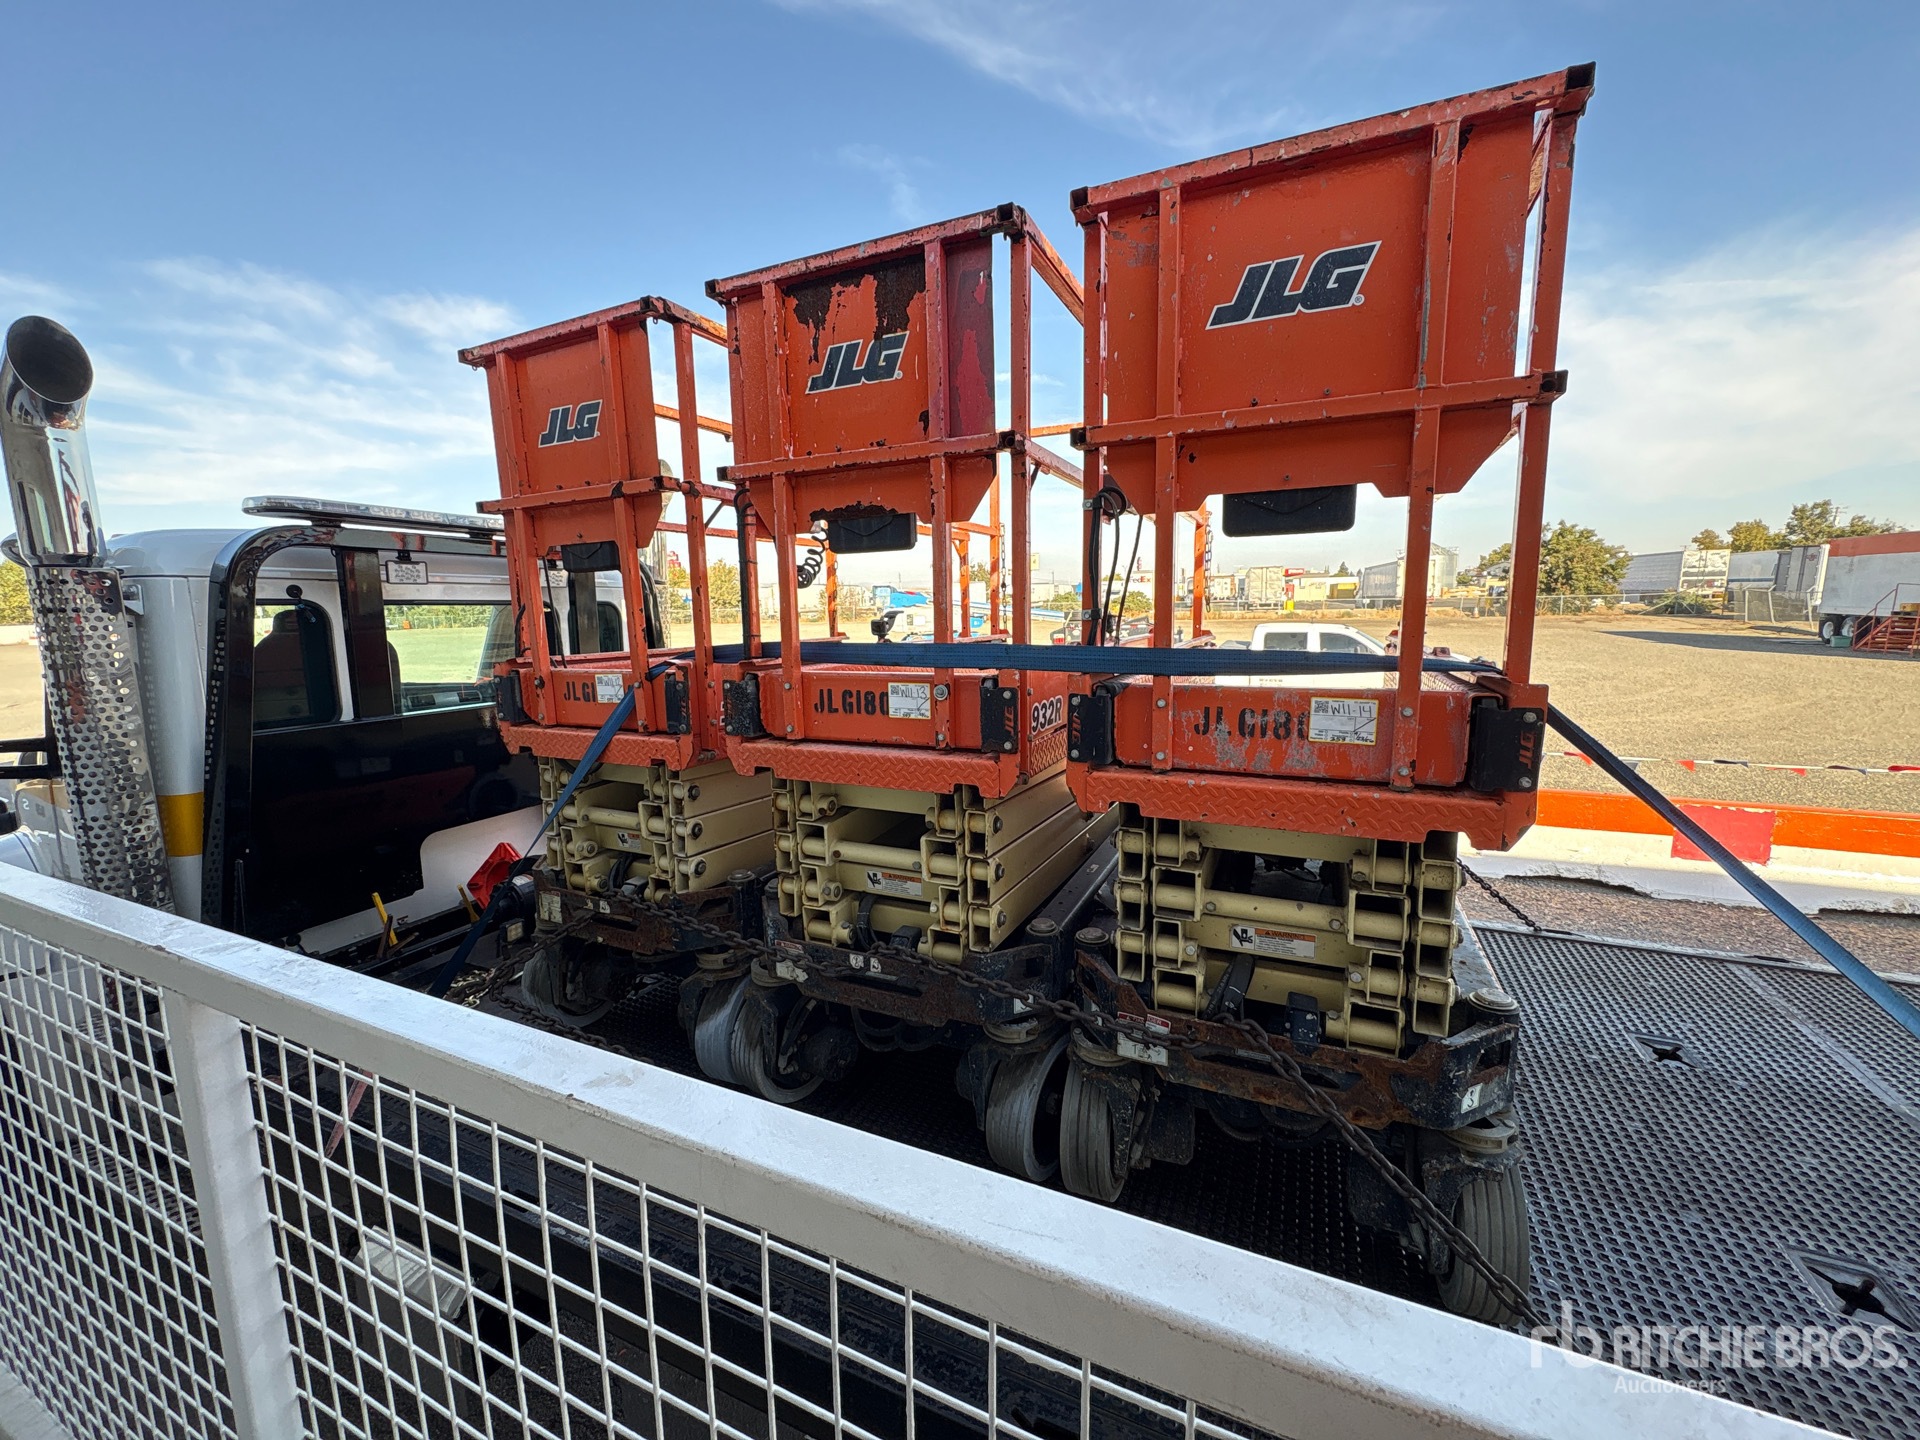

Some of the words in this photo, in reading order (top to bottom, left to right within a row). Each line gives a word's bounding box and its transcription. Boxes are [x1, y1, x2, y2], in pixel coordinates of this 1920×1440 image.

[1205, 240, 1382, 330] JLG
[805, 331, 910, 394] JLG
[538, 399, 603, 448] JLG
[1031, 696, 1063, 734] 932R
[1330, 703, 1372, 718] W11-14
[1519, 731, 1537, 769] JLG
[1271, 929, 1306, 941] WARNING
